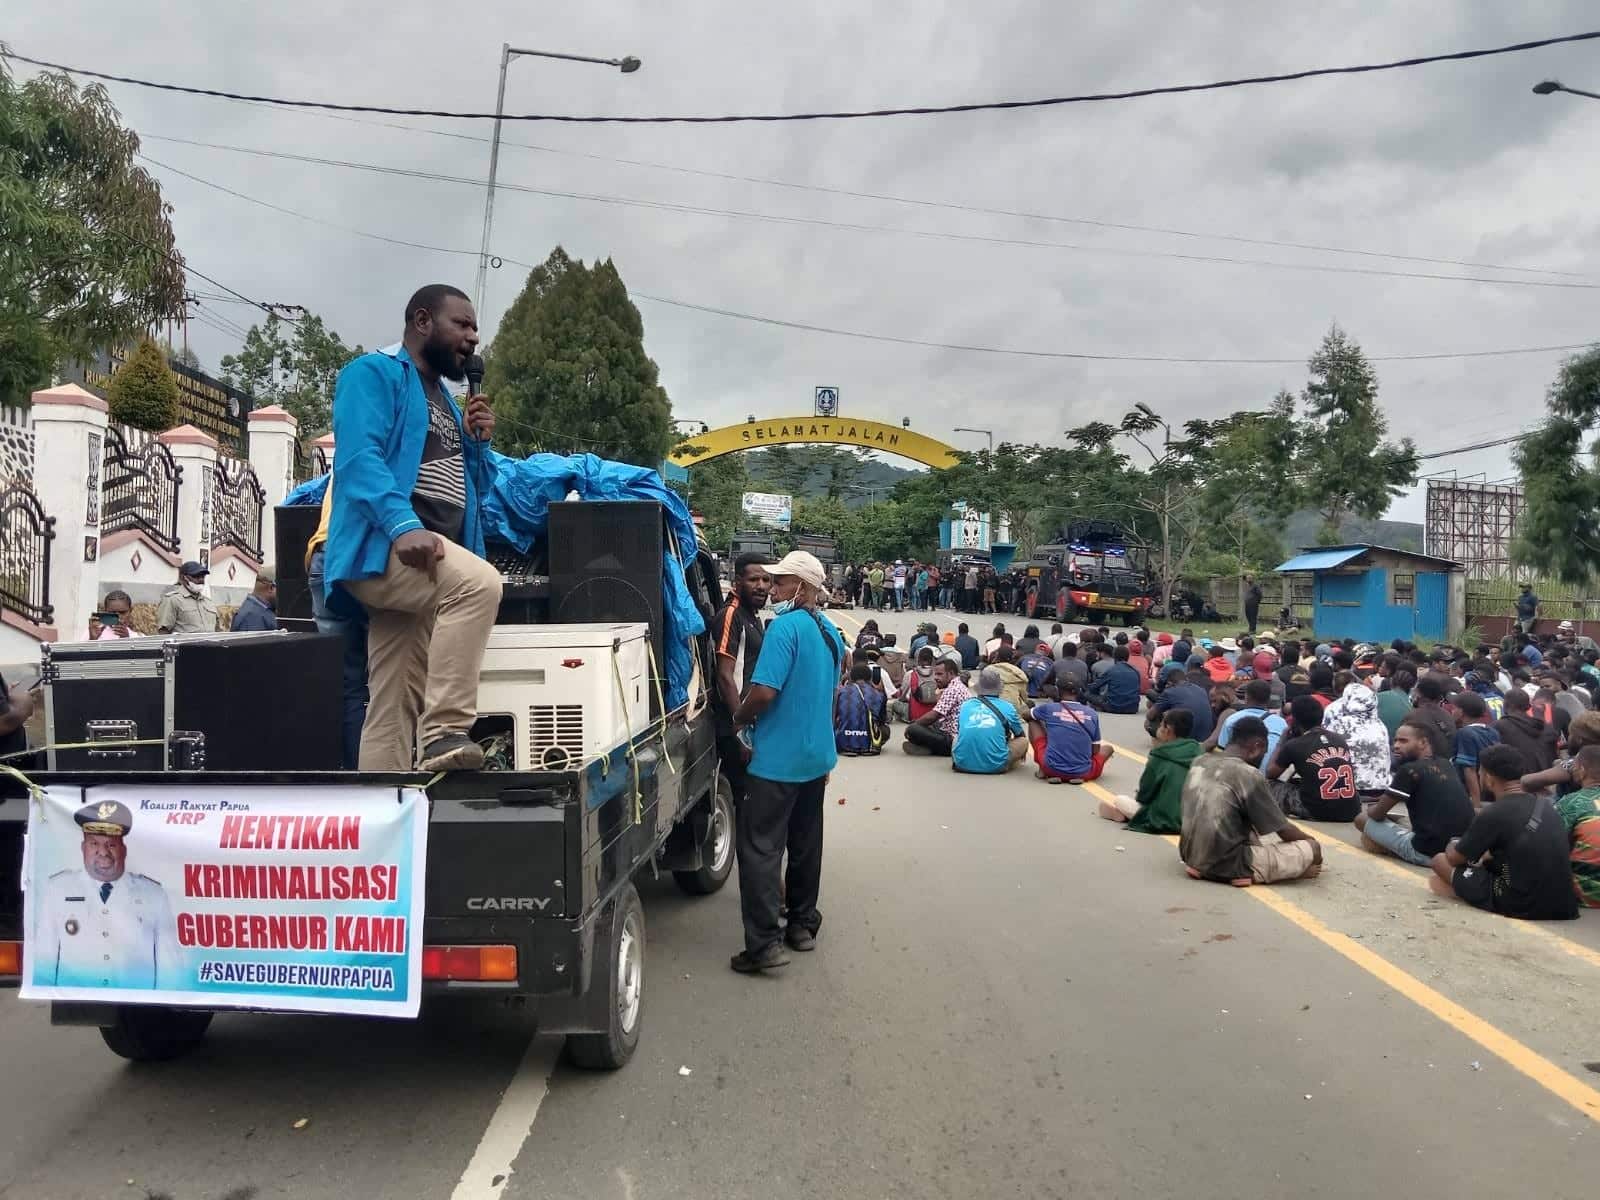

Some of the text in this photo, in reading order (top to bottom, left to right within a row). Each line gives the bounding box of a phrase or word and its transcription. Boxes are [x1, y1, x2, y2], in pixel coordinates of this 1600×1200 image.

[742, 424, 899, 445] SELAMAT JALAN
[1318, 764, 1355, 799] 23
[166, 812, 206, 825] KRP
[219, 815, 361, 850] HENTIKAN
[184, 863, 398, 901] KRIMINALISASI
[466, 897, 552, 910] CARRY
[177, 912, 405, 953] GUBERNUR KAMI
[200, 961, 394, 989] #SAVEGUBERNURPAPUA
